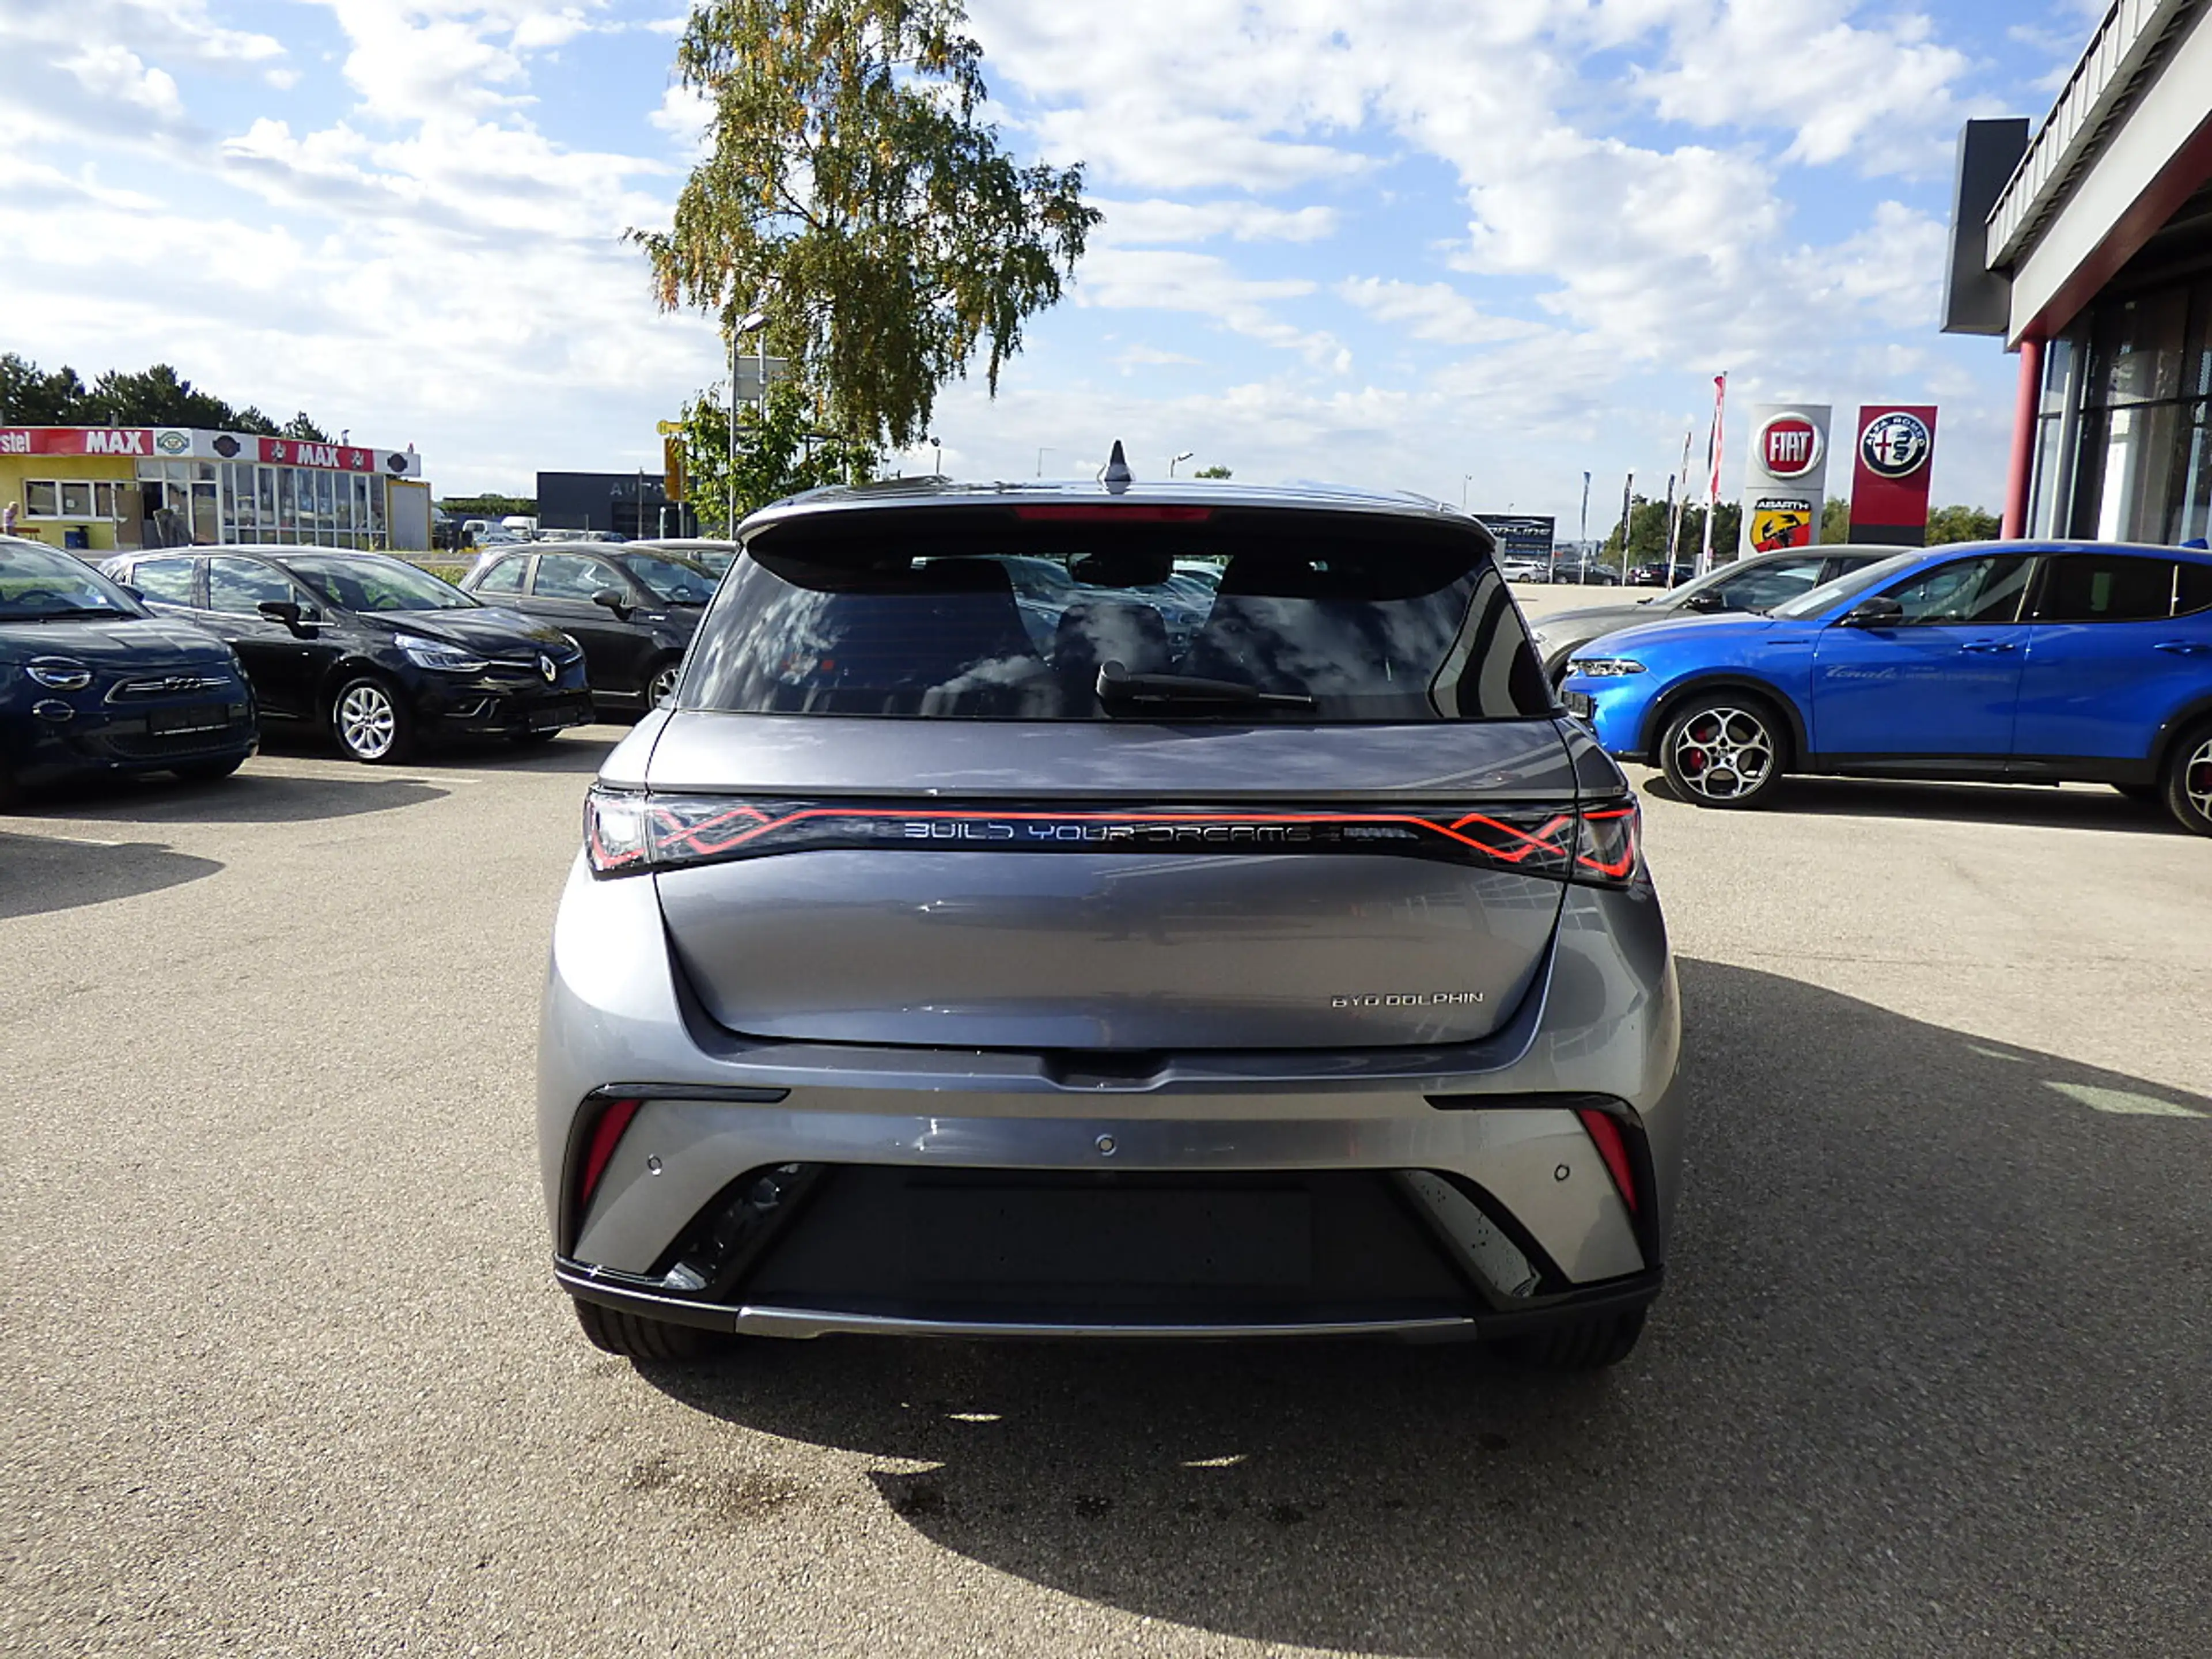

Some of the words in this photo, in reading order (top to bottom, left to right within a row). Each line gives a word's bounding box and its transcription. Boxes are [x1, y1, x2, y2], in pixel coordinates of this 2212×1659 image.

[0, 431, 31, 452] stel
[86, 431, 143, 454] MAX
[1770, 431, 1810, 461] FIAT
[297, 444, 340, 467] MAX
[1758, 501, 1809, 509] ABARTH
[904, 823, 1014, 839] BUILD
[1028, 824, 1135, 842] YOUR
[1147, 827, 1312, 842] DREAMS
[1331, 995, 1380, 1007] BYD
[1385, 992, 1484, 1006] DOLPHIN
